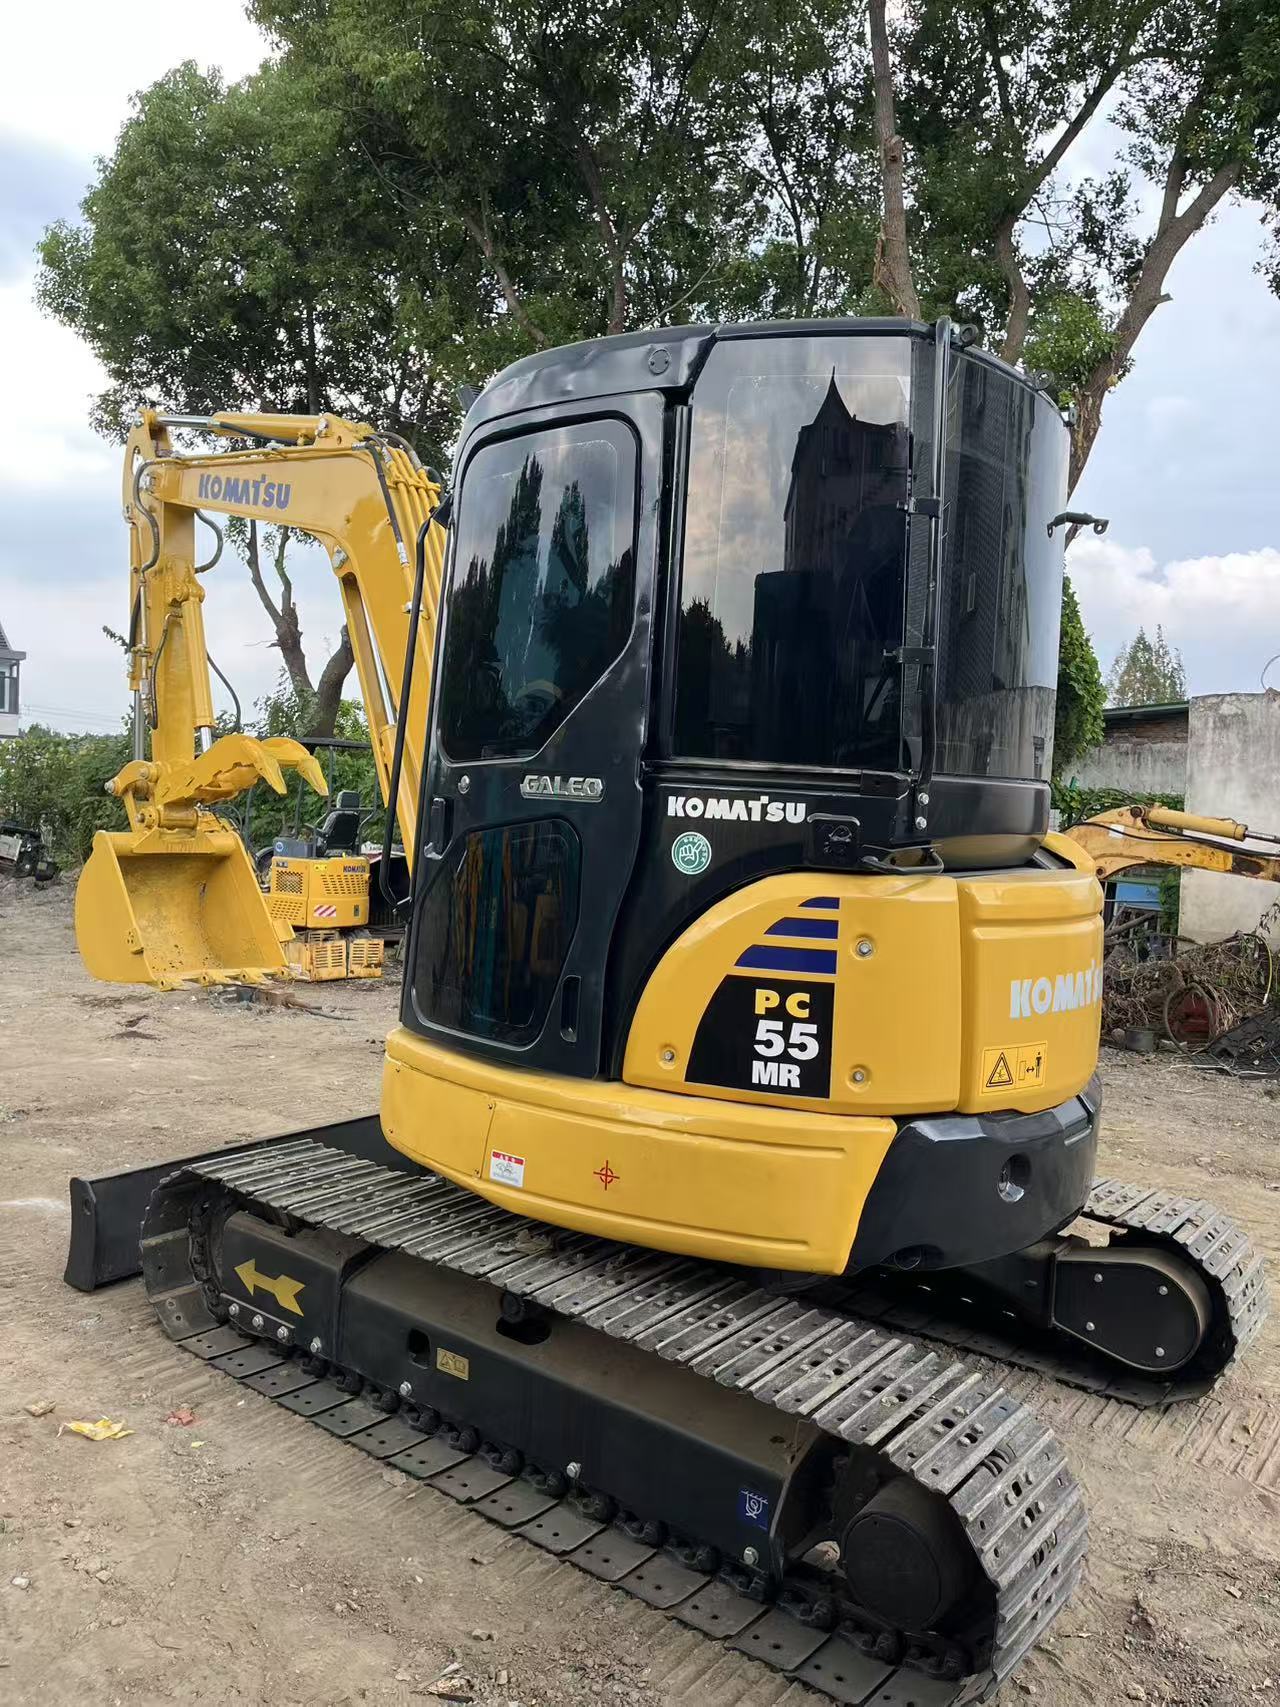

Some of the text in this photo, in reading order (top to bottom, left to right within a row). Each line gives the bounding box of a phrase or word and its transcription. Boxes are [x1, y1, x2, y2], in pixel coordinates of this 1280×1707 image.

[199, 473, 291, 510] KOMATSU
[522, 774, 603, 797] GALEO
[667, 795, 806, 823] KOMATSU
[755, 988, 810, 1018] PC
[753, 1019, 819, 1060] 55
[752, 1060, 800, 1088] MR
